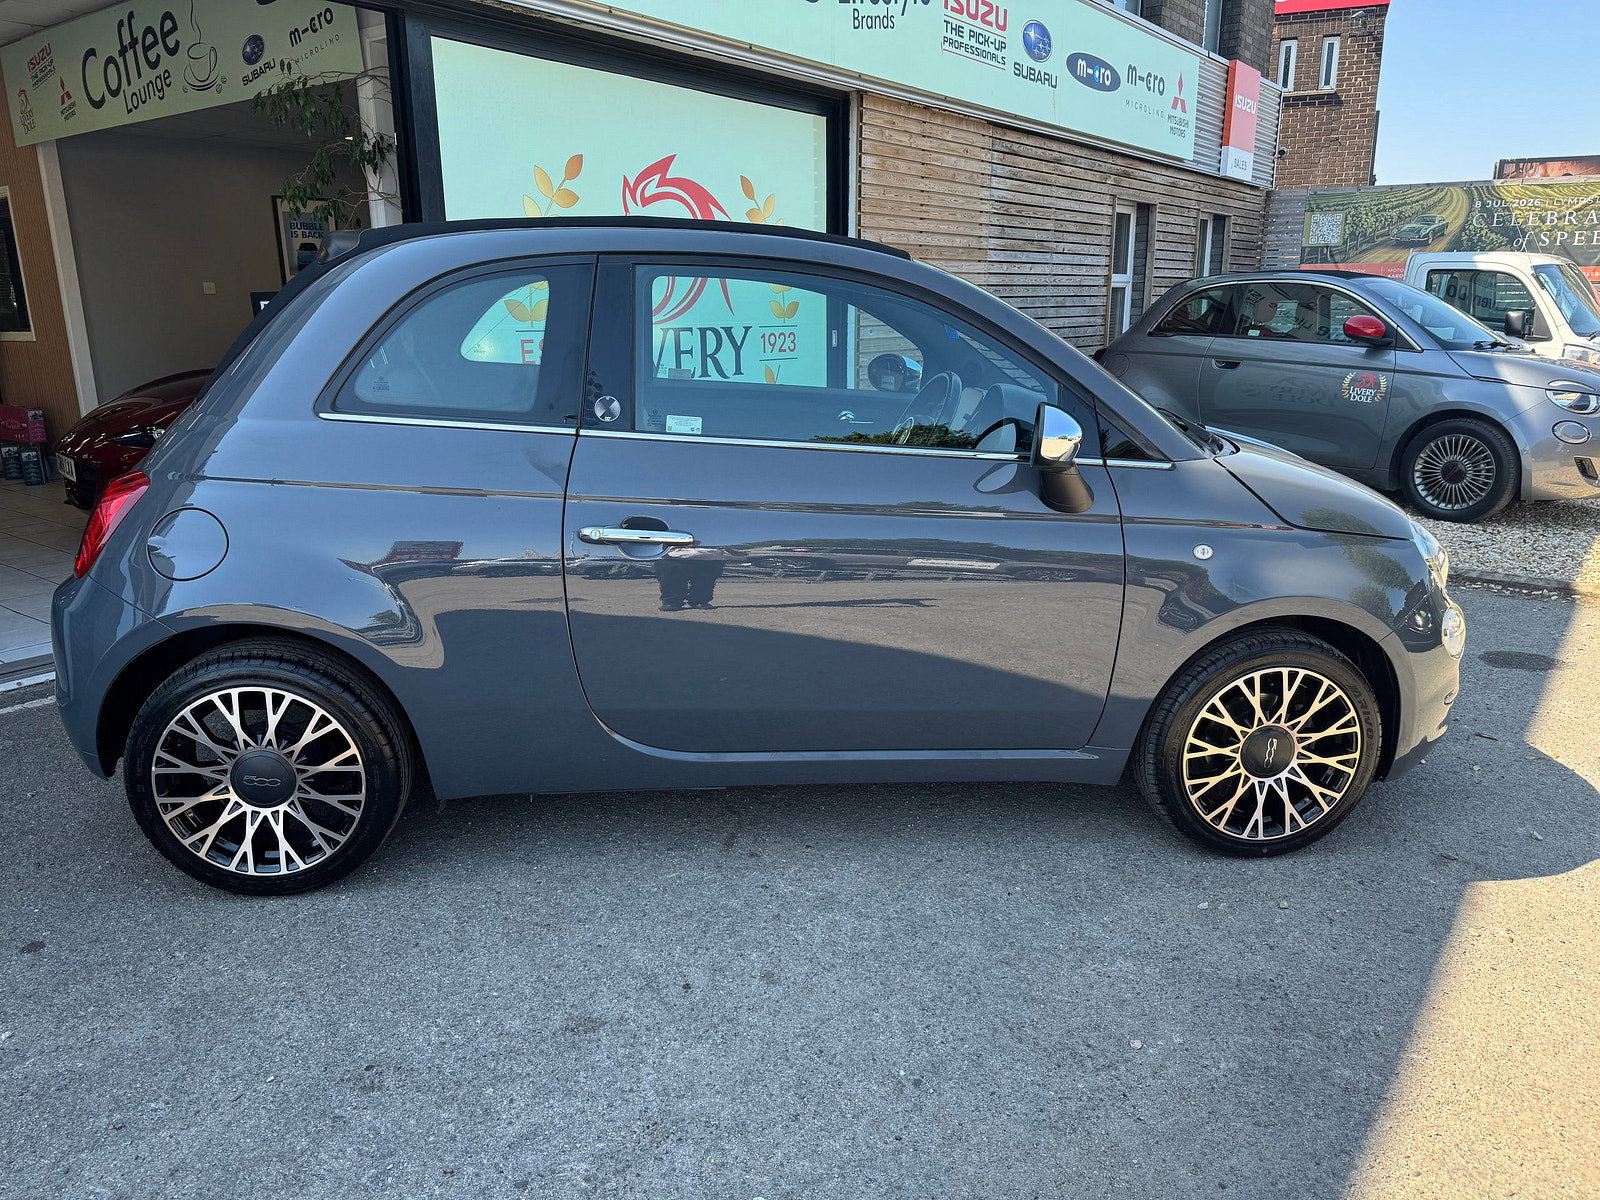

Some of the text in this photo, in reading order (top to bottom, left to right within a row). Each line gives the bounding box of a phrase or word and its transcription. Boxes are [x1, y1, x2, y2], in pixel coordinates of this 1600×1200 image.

[852, 7, 895, 30] Brands
[943, 19, 1007, 53] THE PICK-UP
[27, 43, 52, 73] ISUZU
[294, 33, 341, 64] MICROLINO
[942, 36, 1007, 66] PROFESSIONALS
[82, 10, 180, 110] Coffee
[241, 58, 276, 87] SUBARU
[1012, 61, 1058, 89] SUBARU
[122, 68, 172, 115] Lounge
[1125, 99, 1164, 119] MICROLINO
[1234, 93, 1257, 115] ISUZU
[1167, 113, 1189, 129] MITSUBISHI
[1169, 126, 1186, 139] MOTORS
[1233, 158, 1248, 171] SALES
[1475, 200, 1482, 208] 8
[1486, 200, 1507, 208] JUL
[1512, 199, 1541, 207] 2026
[289, 222, 324, 231] BUBBLE
[1472, 209, 1600, 228] CELEBRA
[291, 231, 324, 239] IS BACK
[1513, 231, 1532, 252] of
[760, 332, 797, 354] 1923
[1349, 386, 1377, 396] LIVERY
[1350, 394, 1373, 403] DOLE
